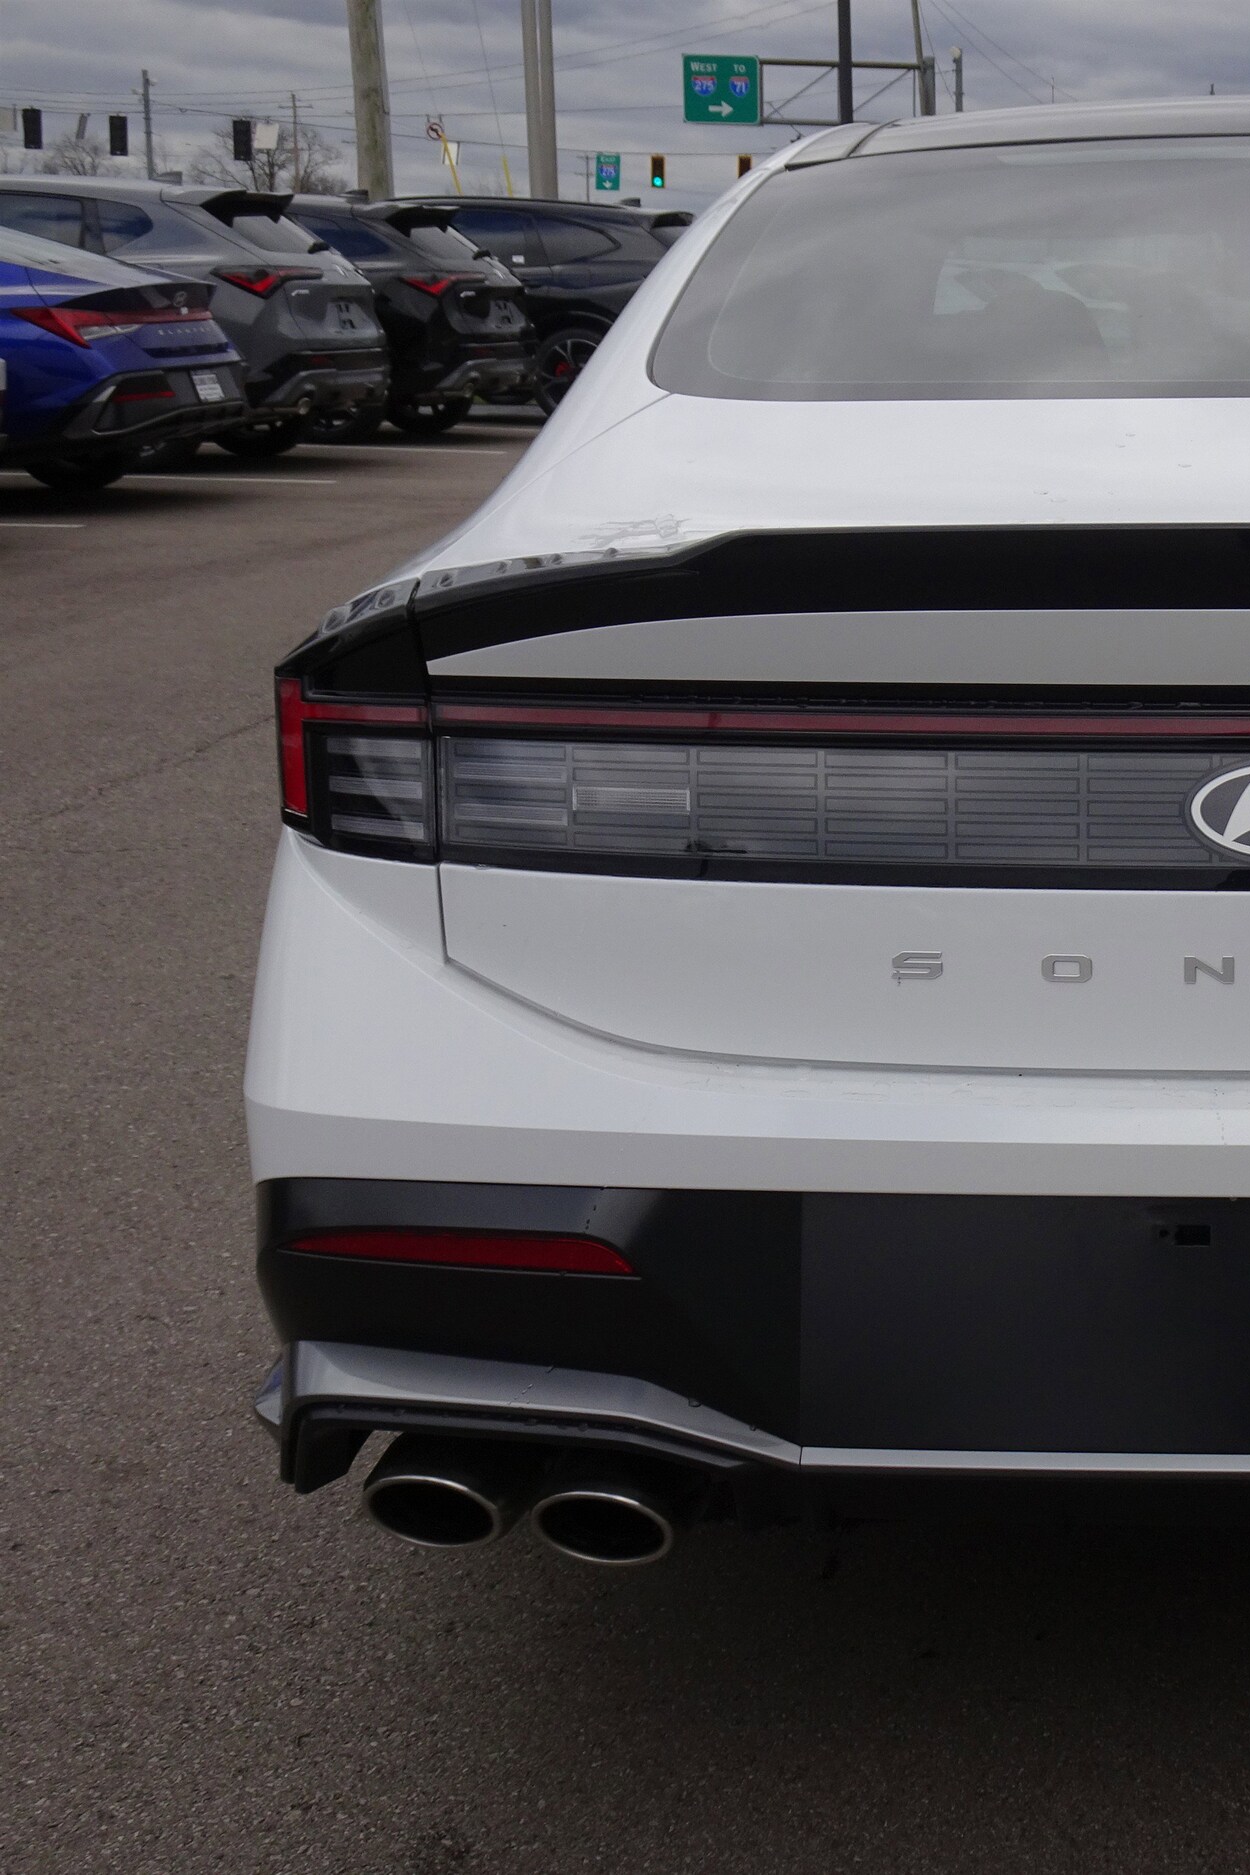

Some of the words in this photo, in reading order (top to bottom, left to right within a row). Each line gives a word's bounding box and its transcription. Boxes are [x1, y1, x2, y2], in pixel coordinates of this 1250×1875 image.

[690, 61, 718, 73] WEST
[733, 64, 746, 73] TO
[695, 80, 714, 91] 275
[735, 81, 746, 93] 71
